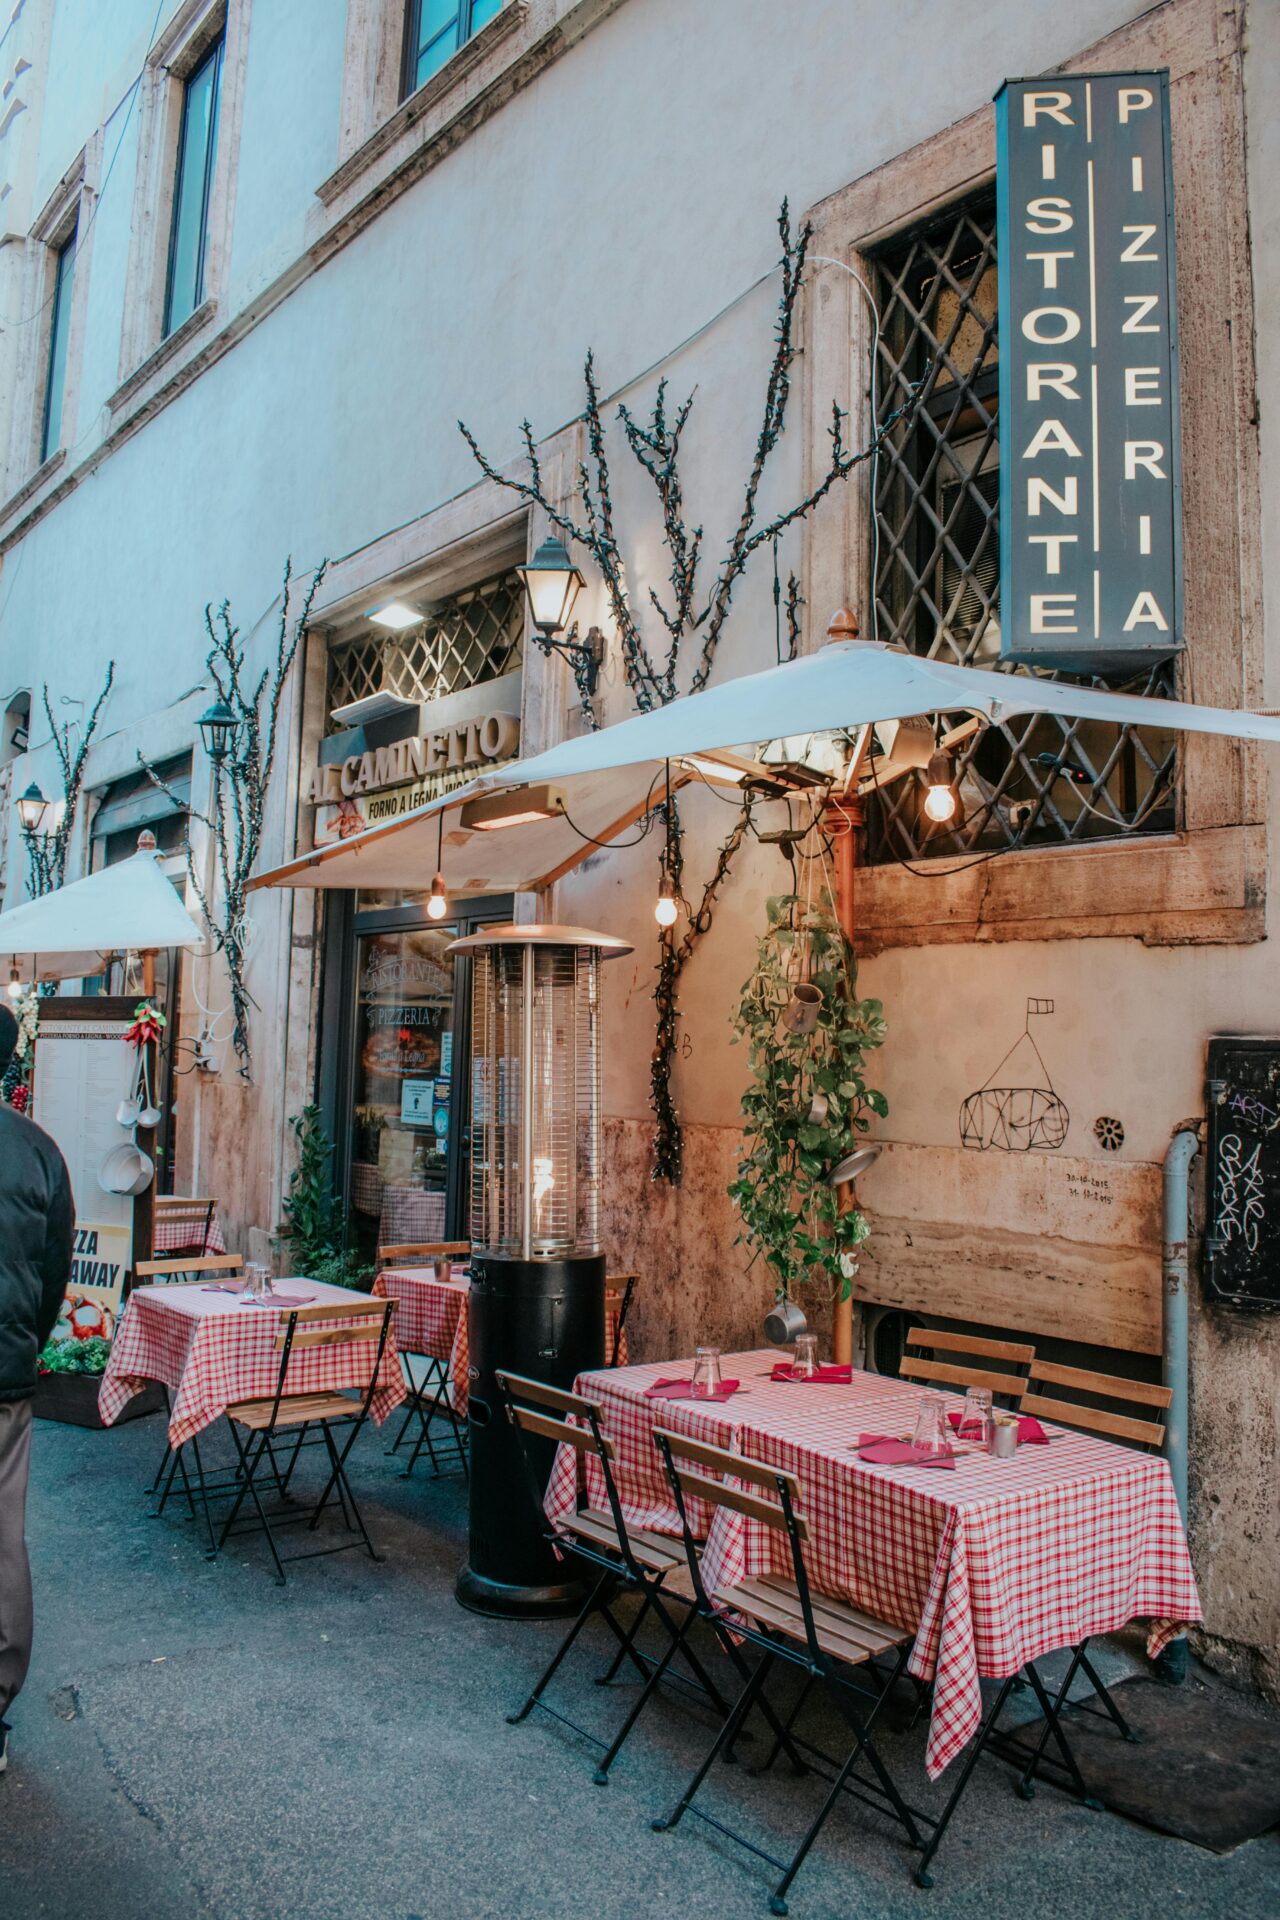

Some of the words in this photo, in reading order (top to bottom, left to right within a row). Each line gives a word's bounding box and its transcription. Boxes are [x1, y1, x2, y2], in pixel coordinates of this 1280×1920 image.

[1021, 91, 1082, 635] RISTORANTE
[1117, 88, 1168, 632] PIZZERIA
[308, 763, 341, 802] AL
[341, 711, 517, 797] CAMINETTO
[368, 797, 398, 821] FORNO
[399, 795, 407, 814] A
[371, 961, 440, 990] RISTORANTE
[378, 1007, 431, 1025] PIZZERIA
[1229, 1093, 1277, 1123] ART
[73, 1229, 98, 1255] ZZA
[70, 1259, 120, 1289] AWAY
